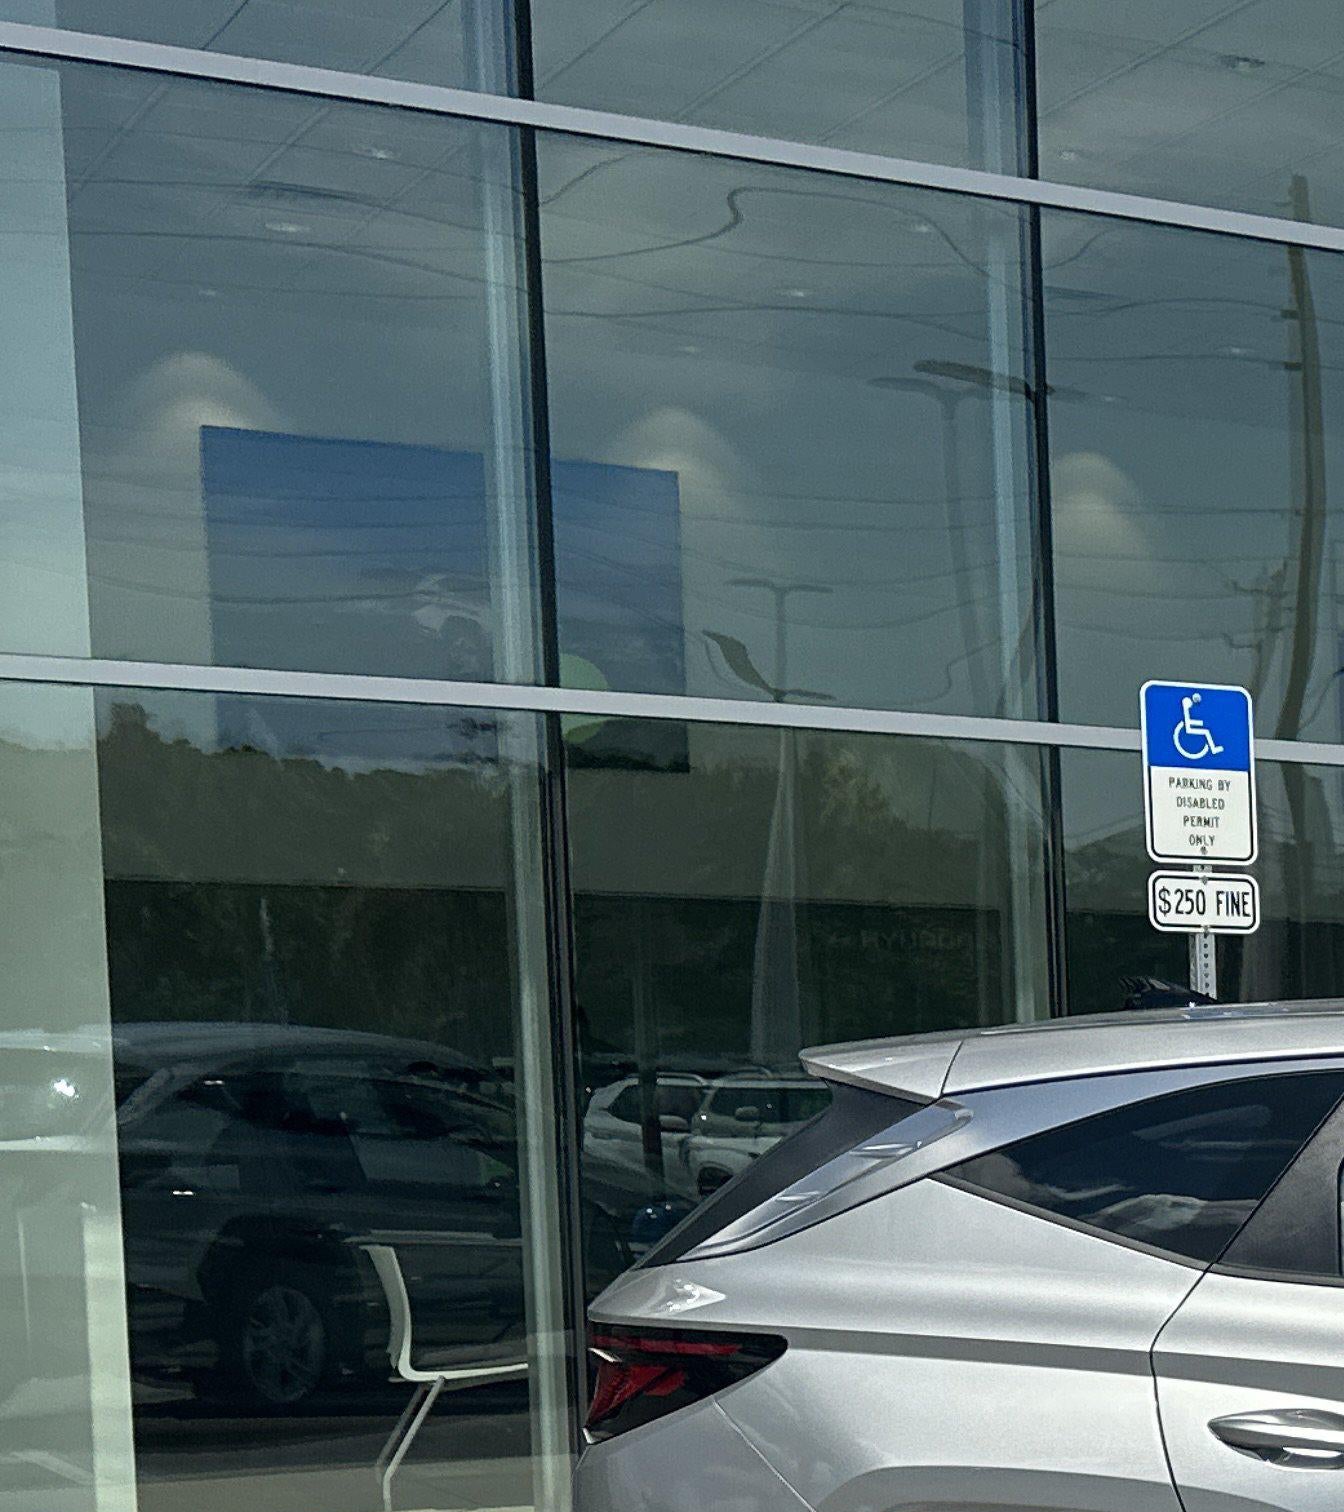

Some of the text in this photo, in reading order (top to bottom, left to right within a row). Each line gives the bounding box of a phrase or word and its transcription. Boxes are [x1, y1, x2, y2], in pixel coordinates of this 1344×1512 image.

[1168, 776, 1231, 791] PARKING BY
[1176, 796, 1225, 810] DISABLED
[1183, 815, 1220, 828] PERMIT
[1188, 833, 1215, 847] ONLY
[1158, 885, 1251, 917] $250 FINE
